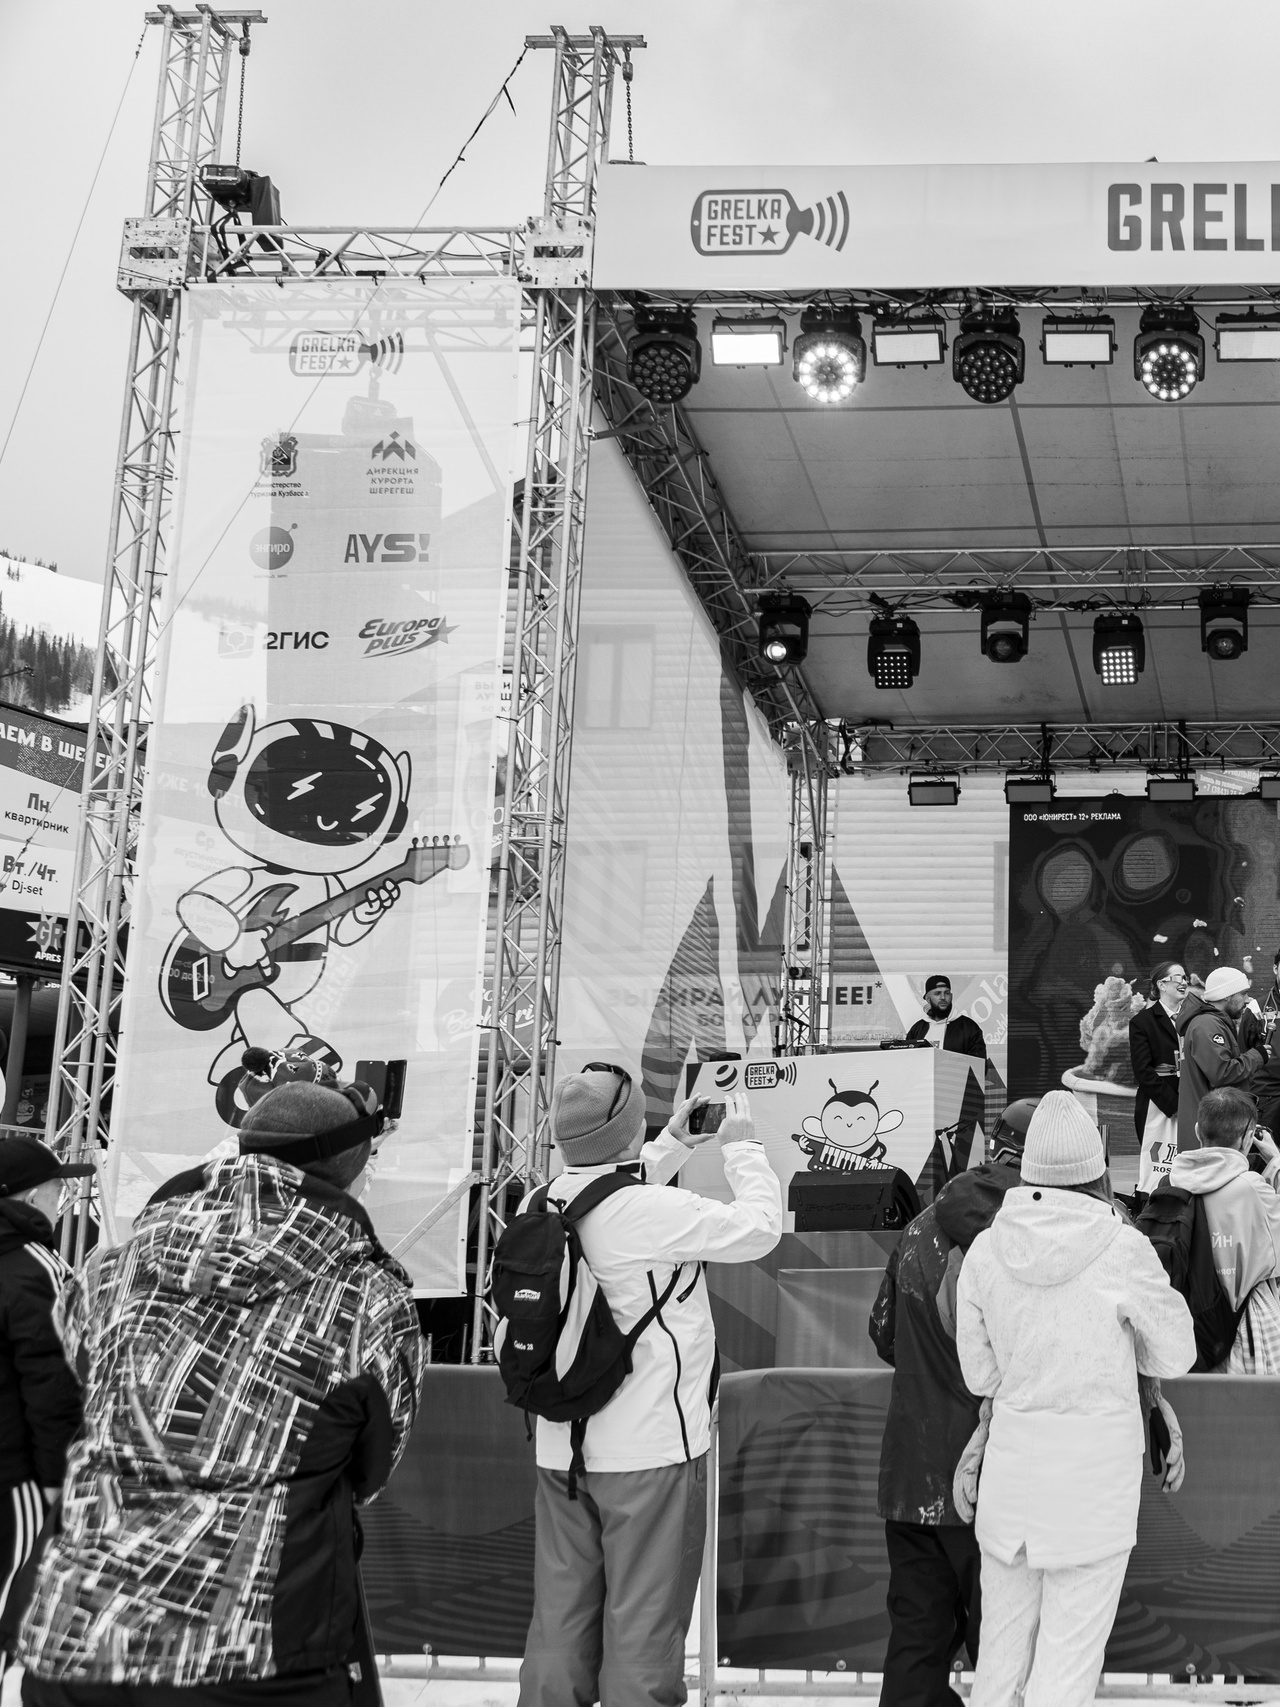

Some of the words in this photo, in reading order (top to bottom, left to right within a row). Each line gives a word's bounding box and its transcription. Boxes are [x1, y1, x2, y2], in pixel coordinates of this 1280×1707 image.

[708, 199, 782, 220] GRELKA
[707, 225, 757, 246] FEST
[301, 337, 355, 352] GRELKA
[299, 355, 337, 370] FEST
[366, 467, 419, 476] ДИРЕКЦИЯ
[370, 477, 414, 486] КУРОРТА
[369, 487, 414, 495] ШЕРЕГЕШ
[358, 617, 440, 639] Europa
[1091, 811, 1122, 821] РЕКЛАМА
[4, 811, 70, 835] квартирник
[12, 879, 44, 896] Dj-set
[35, 951, 62, 963] APRES
[749, 1065, 775, 1076] GRELKA
[749, 1076, 766, 1087] FEST
